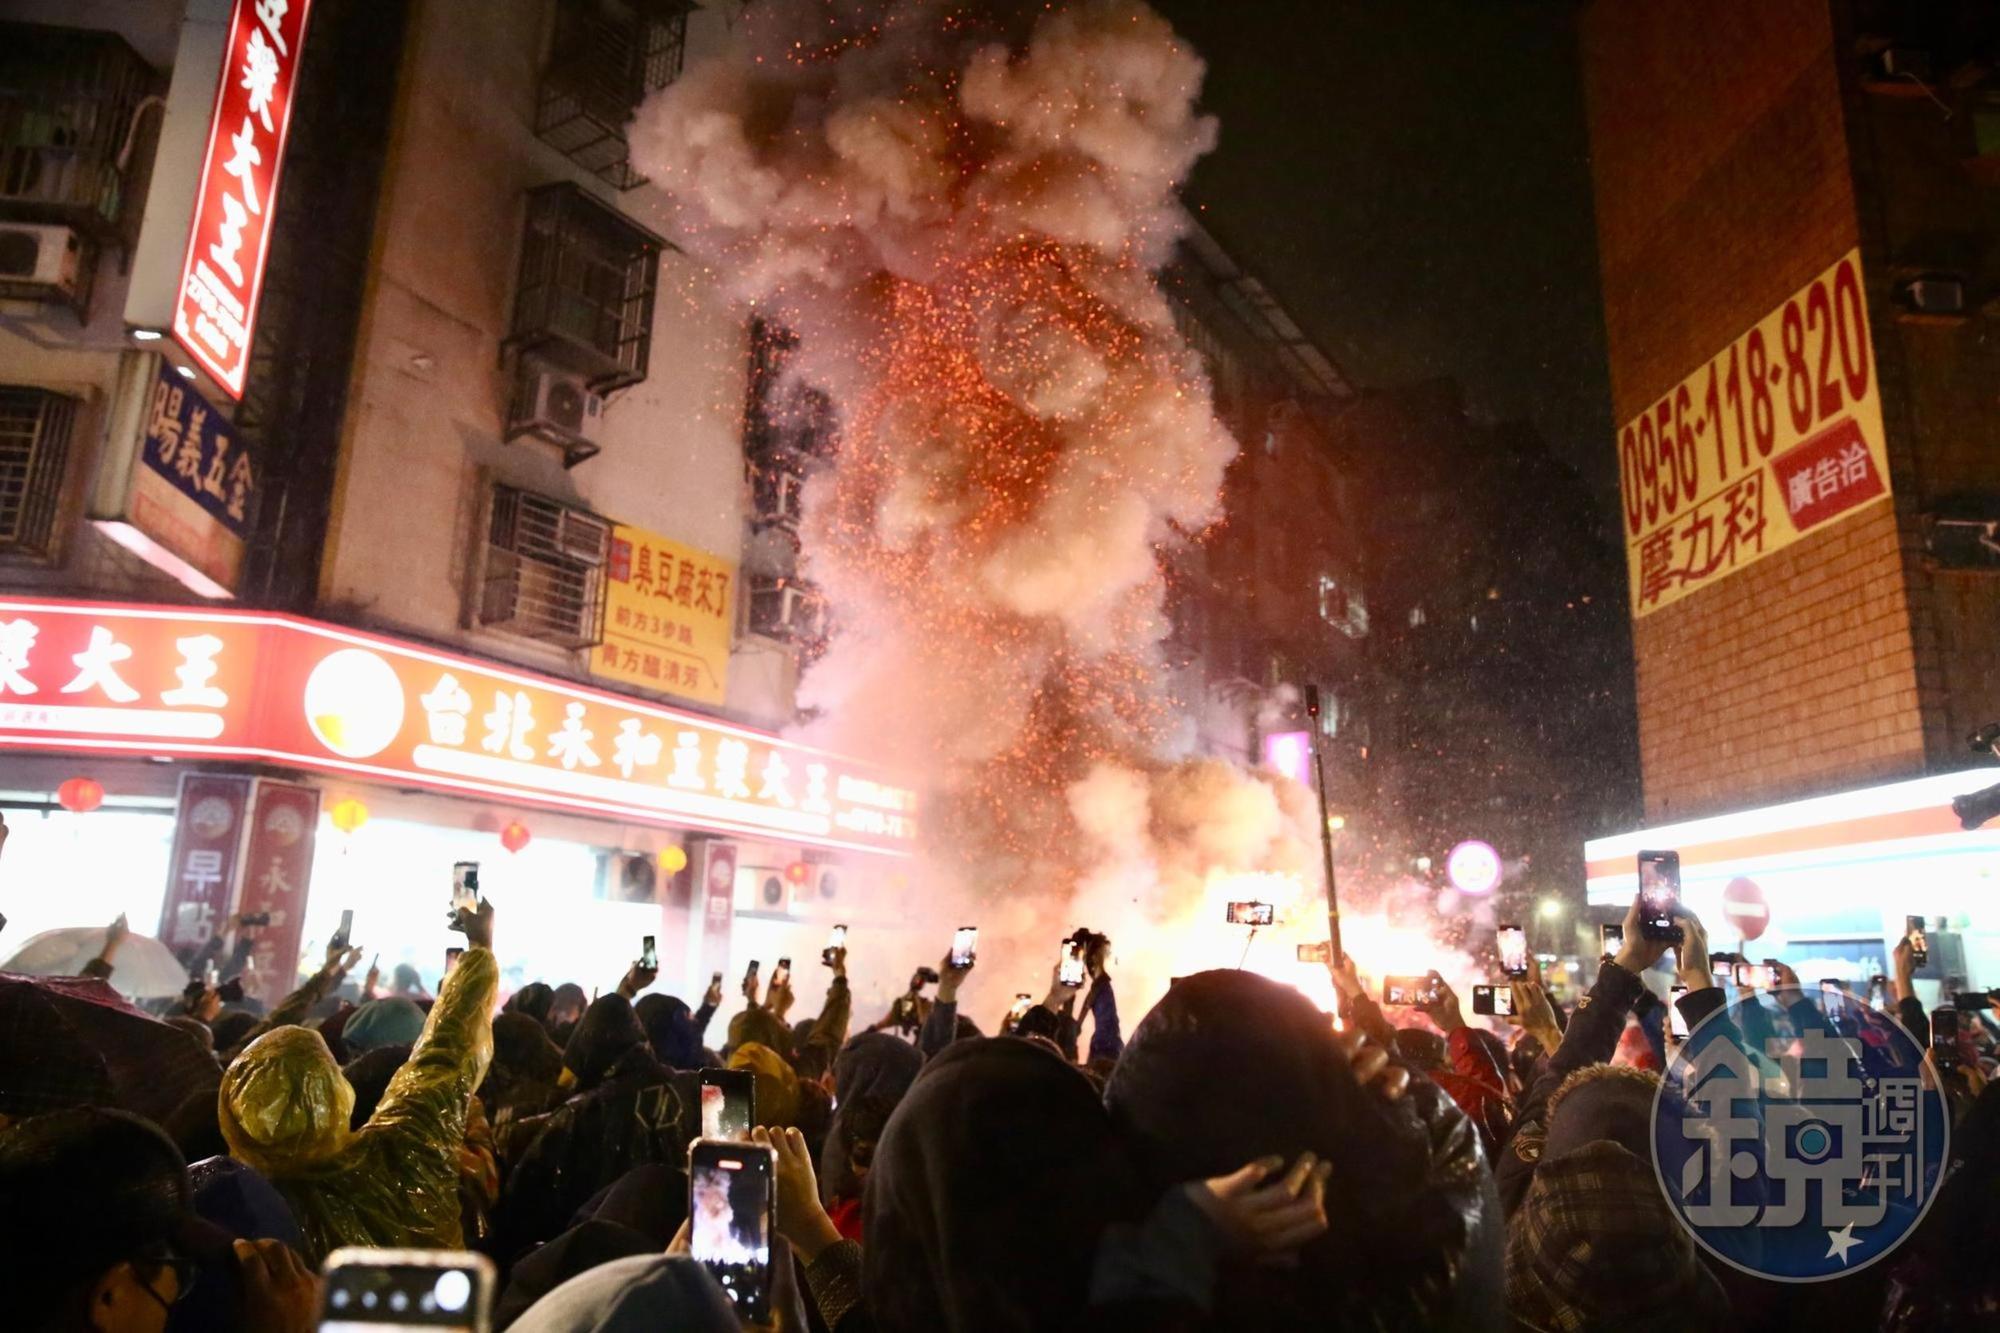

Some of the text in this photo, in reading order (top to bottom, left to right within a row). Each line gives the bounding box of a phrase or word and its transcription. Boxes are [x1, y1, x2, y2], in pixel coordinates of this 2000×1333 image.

[148, 380, 254, 523] 陽義五金
[420, 672, 831, 813] 台北永和豆漿大王
